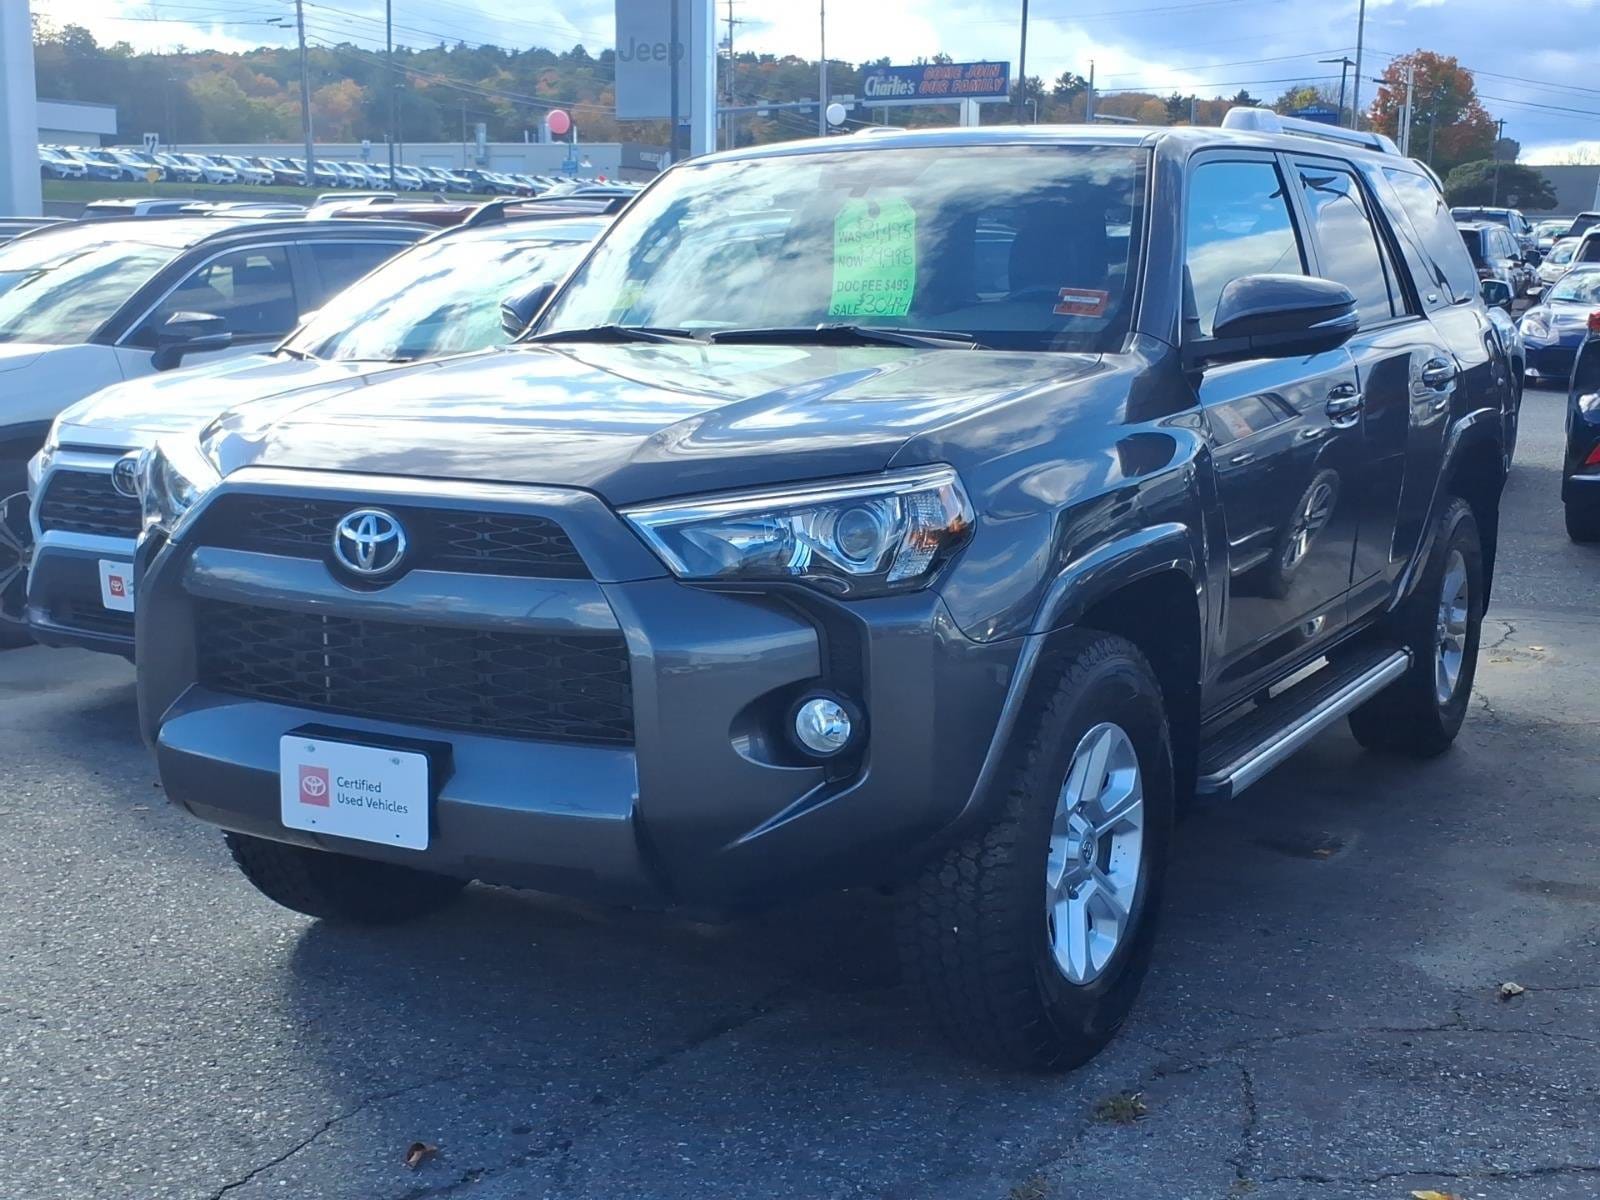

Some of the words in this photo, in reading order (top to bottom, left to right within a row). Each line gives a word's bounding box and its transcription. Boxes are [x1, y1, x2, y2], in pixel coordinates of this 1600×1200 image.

[618, 36, 685, 67] Jeep
[923, 65, 963, 81] COME
[966, 63, 1001, 79] JOIN
[864, 76, 915, 97] Charlie's
[919, 80, 950, 95] OUR
[951, 77, 1005, 94] FAMILY
[838, 231, 863, 242] WAS
[838, 254, 864, 268] NOW
[836, 280, 860, 292] DOC
[860, 280, 883, 292] FEE
[885, 279, 908, 292] $499
[833, 303, 861, 315] SALE
[336, 776, 382, 793] Certified
[337, 793, 363, 807] Used
[365, 797, 409, 814] Vehicles
